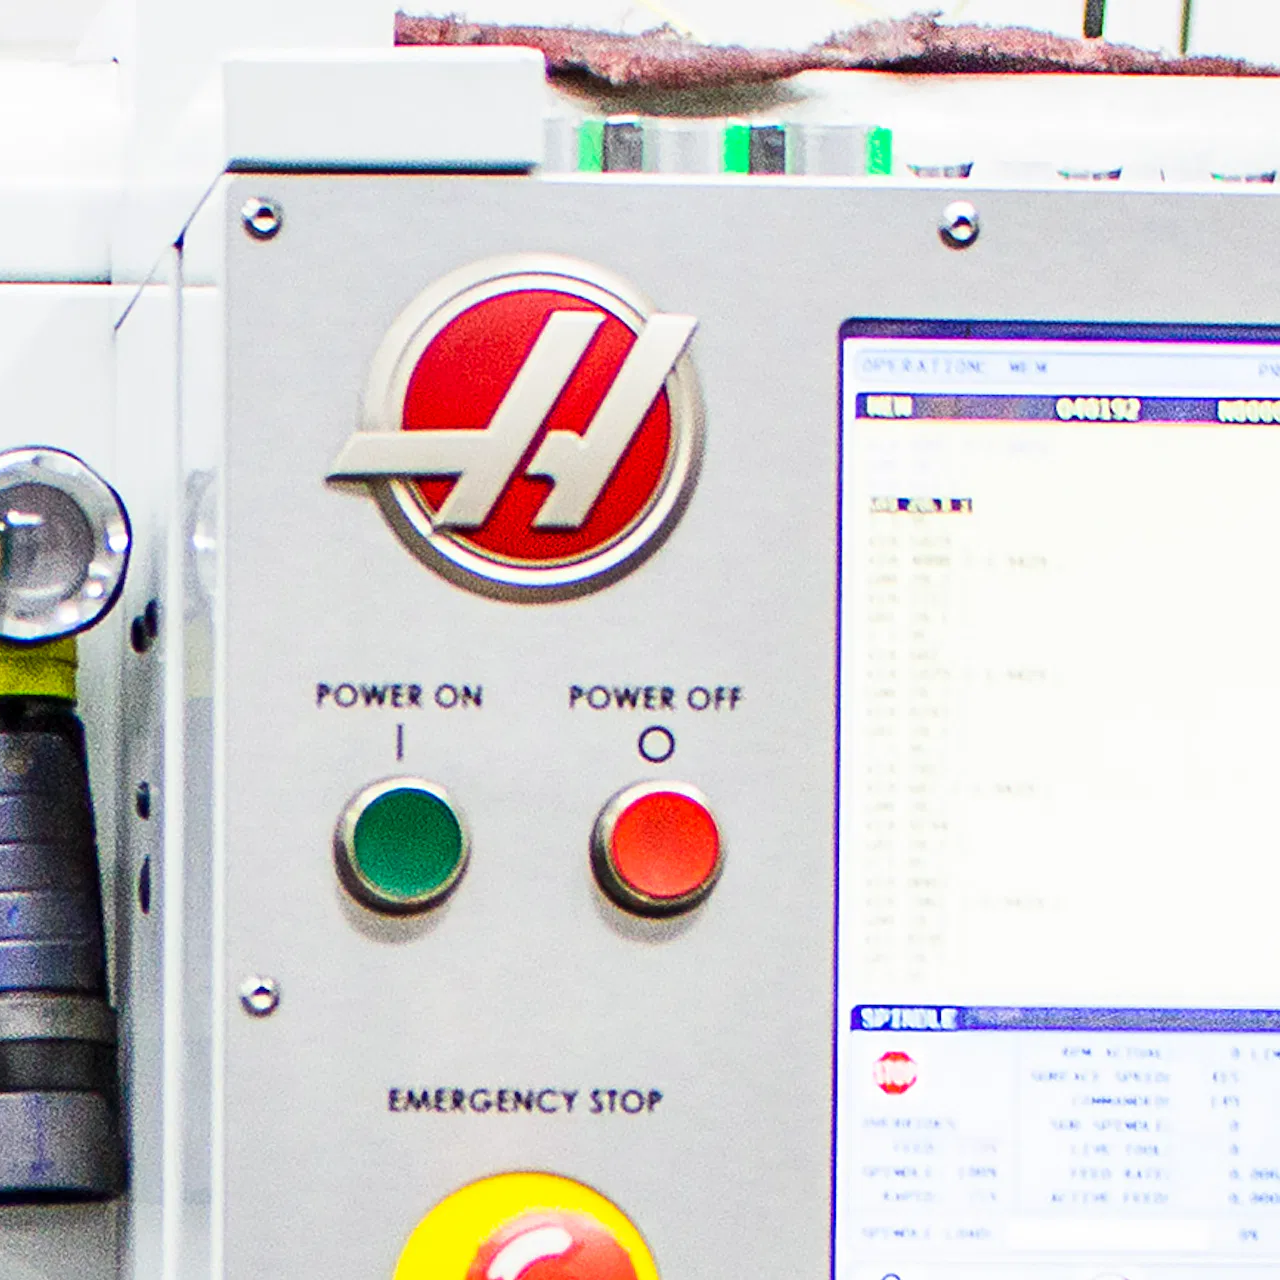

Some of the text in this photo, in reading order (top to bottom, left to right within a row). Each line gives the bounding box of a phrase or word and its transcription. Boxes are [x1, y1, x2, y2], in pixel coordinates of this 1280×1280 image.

[315, 682, 484, 709] POWER ON
[568, 684, 744, 711] POWER OFF
[860, 1008, 958, 1030] SPINDLE
[387, 1088, 665, 1114] EMERGENCY STOP
